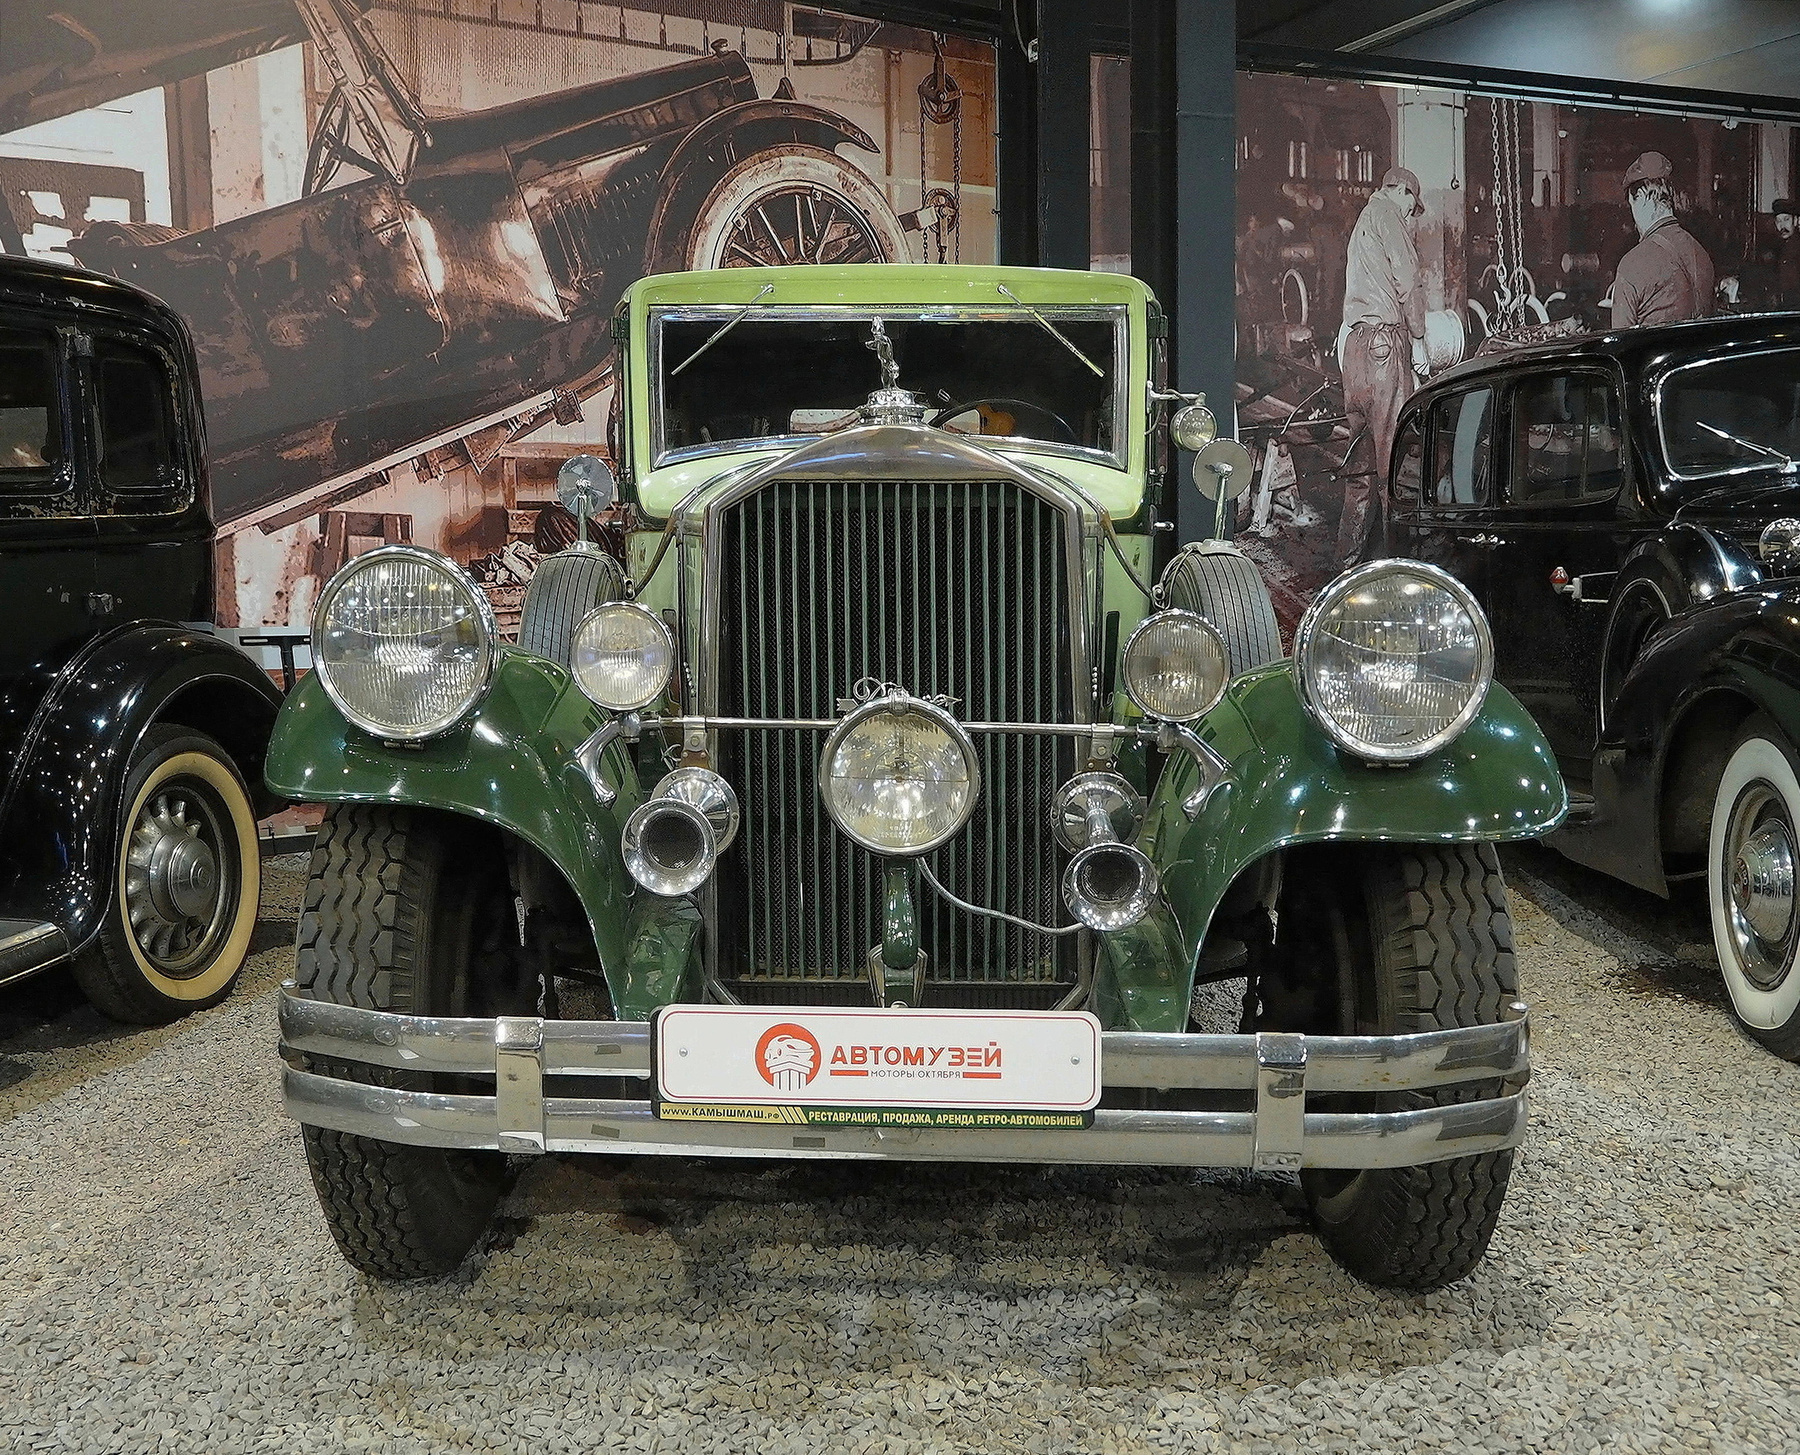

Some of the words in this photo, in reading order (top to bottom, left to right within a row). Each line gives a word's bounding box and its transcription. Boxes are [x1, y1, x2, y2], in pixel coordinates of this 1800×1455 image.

[830, 1041, 1002, 1068] АВТОМУЗЕЙ
[870, 1069, 915, 1079] МОТОРЫ
[917, 1070, 961, 1079] ОКТЯБРЯ
[808, 1111, 881, 1124] РЕСТАВРАЦИЯ,
[883, 1112, 934, 1125] ПРОДАЖА,
[936, 1114, 975, 1126] АРЕНДА
[976, 1114, 1083, 1126] РЕТРО-АВТОМОБИЛЕЙ
